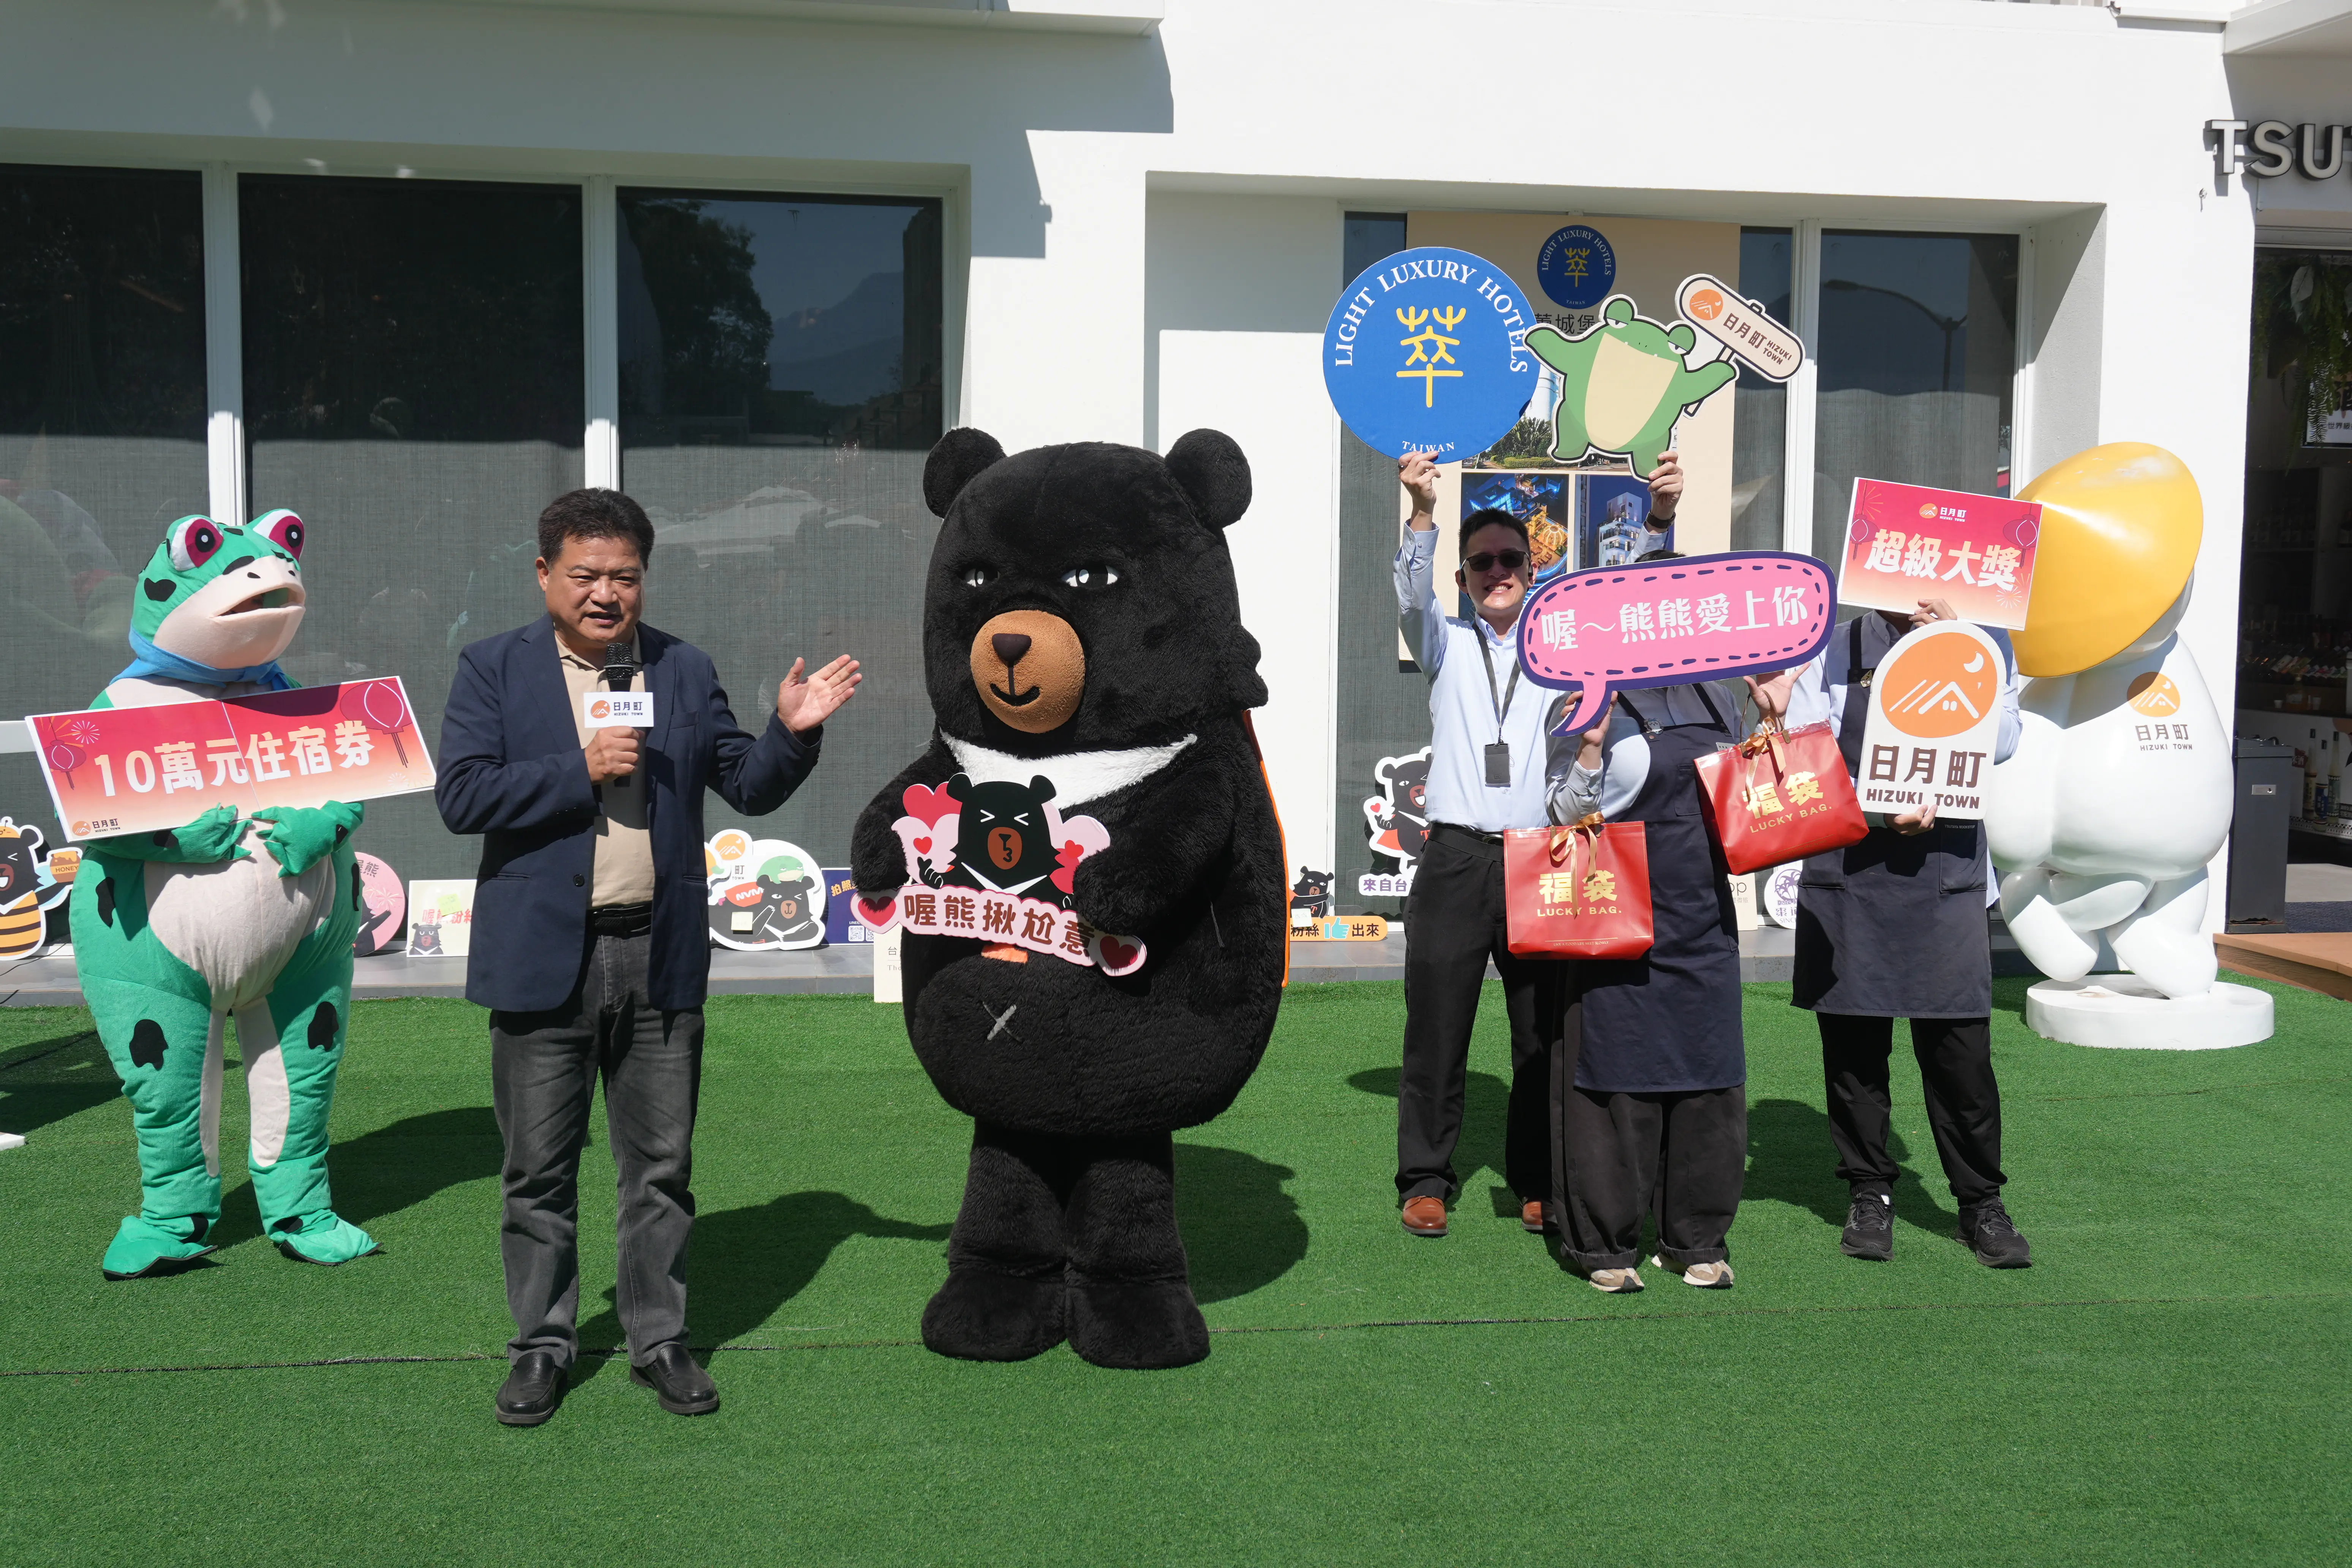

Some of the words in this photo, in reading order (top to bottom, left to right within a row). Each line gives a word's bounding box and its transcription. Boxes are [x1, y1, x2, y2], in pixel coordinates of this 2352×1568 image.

[2205, 119, 2352, 182] TSU
[1542, 239, 1558, 270] LIGHT
[1558, 229, 1594, 242] LUXURY
[1594, 237, 1612, 275] HOTELS
[1335, 287, 1375, 367] LIGHT
[1377, 259, 1477, 292] LUXURY
[1477, 277, 1528, 373] HOTELS
[1723, 313, 1767, 349] 日月町
[1763, 348, 1783, 365] TOWN
[1767, 340, 1792, 360] HIZUKI
[1402, 440, 1454, 452] TAIWAN
[1940, 507, 1967, 518] 日月町
[1864, 528, 2022, 591] 超級大獎
[613, 702, 643, 711] 日月町
[2135, 724, 2189, 741] 日月町
[94, 719, 375, 797] 10萬元住宿券
[1868, 744, 1987, 788] 日月町
[1742, 771, 1823, 819] 福袋
[1866, 789, 1923, 805] HIZUKI
[1934, 793, 1980, 809] TOWN
[92, 818, 118, 828] 日月町
[1750, 813, 1793, 833] LUCKY
[1799, 804, 1832, 818] BAG.
[1363, 878, 1413, 891] 來自台
[1539, 870, 1618, 904] 福袋
[1537, 907, 1582, 917] LUCKY
[1589, 906, 1622, 915] BAG.
[904, 894, 1095, 957] 喔熊揪尬意
[1352, 923, 1379, 937] 出來
